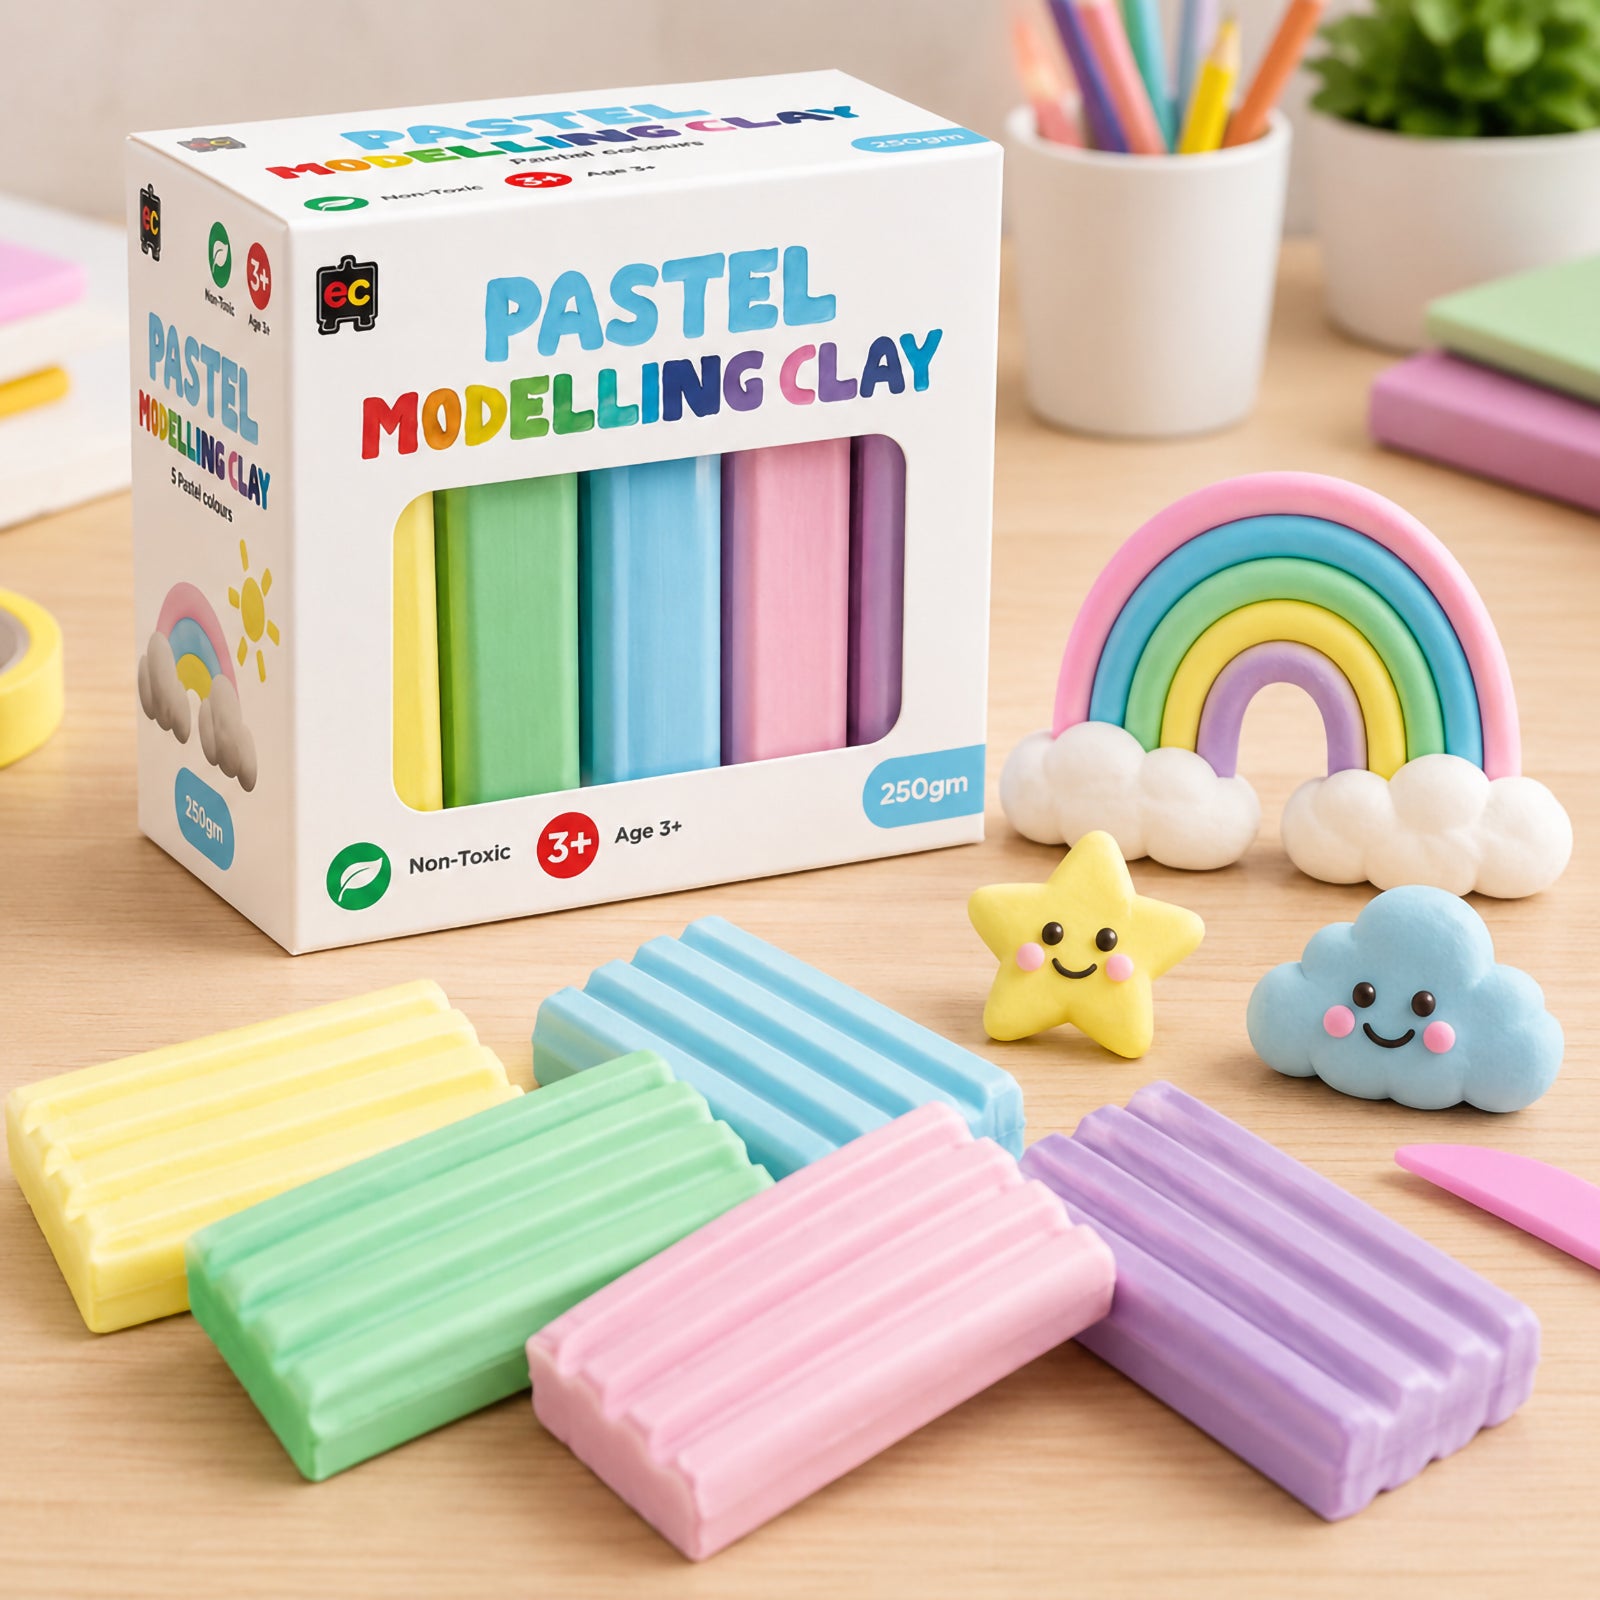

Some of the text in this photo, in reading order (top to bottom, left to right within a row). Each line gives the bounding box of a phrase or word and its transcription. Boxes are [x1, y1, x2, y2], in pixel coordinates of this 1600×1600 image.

[265, 105, 859, 179] MODELLING CLAY
[340, 103, 711, 150] PASTEL
[871, 132, 965, 149] 250gm
[515, 175, 562, 187] 3+
[588, 168, 627, 178] Age
[142, 205, 159, 236] ec
[250, 257, 269, 292] 3+
[323, 278, 371, 309] ec
[485, 245, 837, 363] PASTEL
[148, 311, 259, 446] PASTEL
[361, 328, 943, 460] MODELLING CLAY
[138, 388, 271, 511] MODELLING CLAY
[171, 466, 177, 485] 5
[203, 491, 233, 523] colours
[879, 775, 968, 806] 250gm
[185, 794, 224, 845] 250gm
[614, 820, 682, 845] Age 3+
[409, 843, 512, 875] Non-Toxic
[547, 830, 592, 864] 3+
